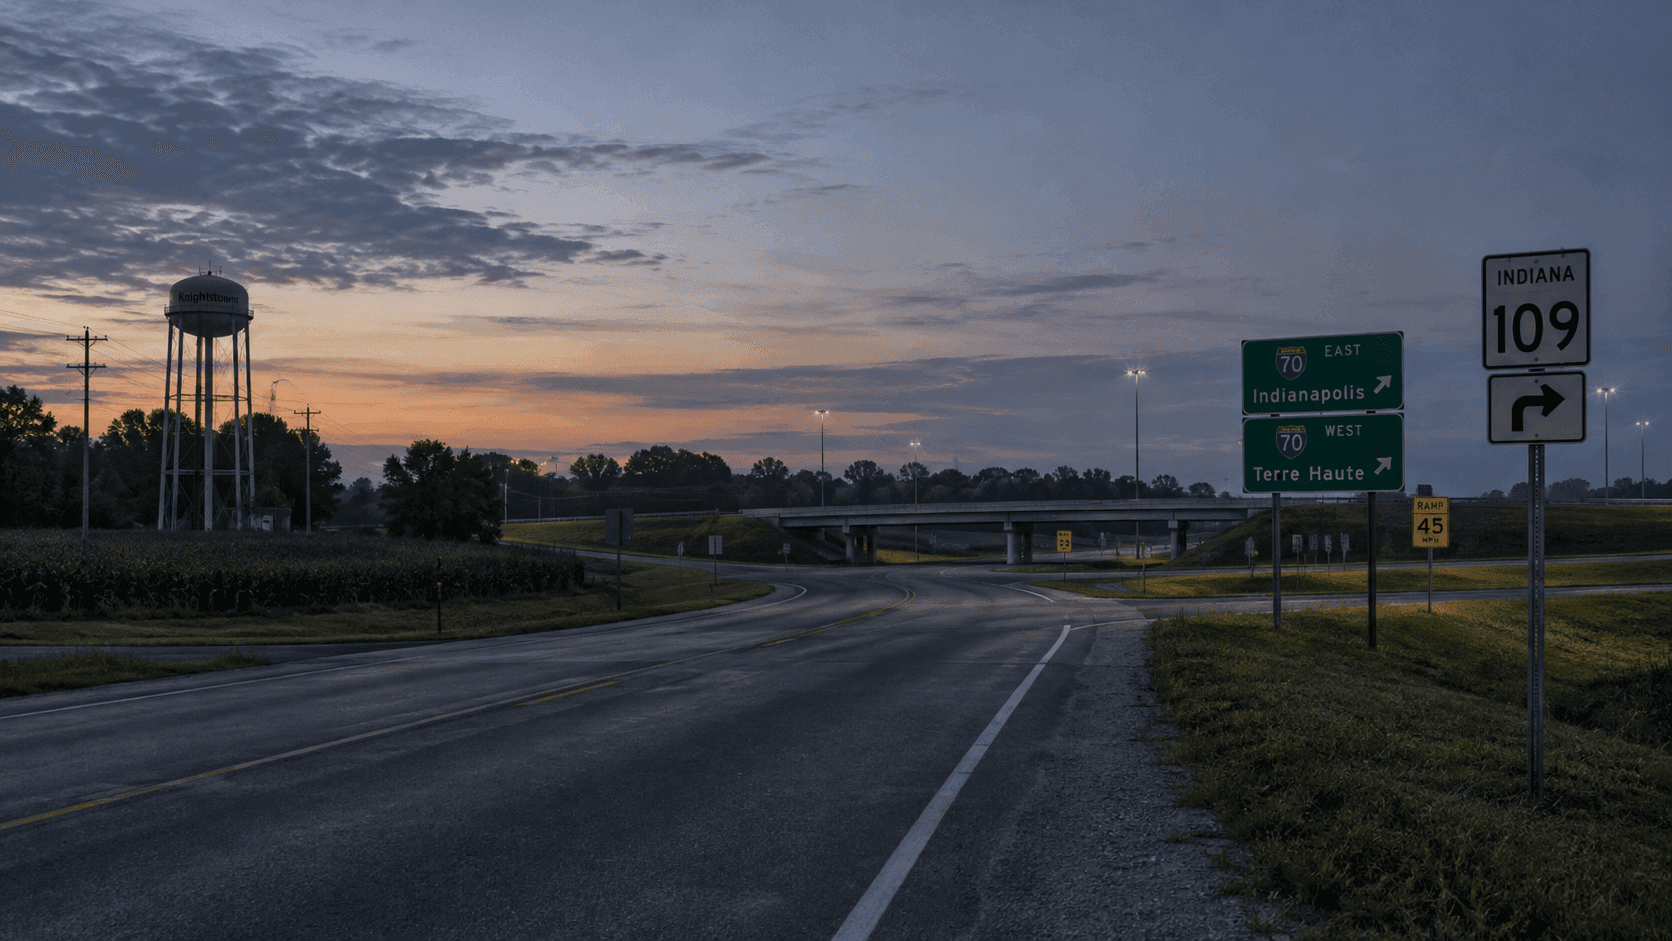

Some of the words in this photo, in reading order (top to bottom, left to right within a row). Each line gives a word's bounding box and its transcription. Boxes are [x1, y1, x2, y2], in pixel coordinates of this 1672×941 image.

[1497, 265, 1575, 286] INDIANA
[1493, 300, 1580, 354] 109
[1324, 344, 1361, 357] EAST
[1280, 355, 1303, 373] 70
[1253, 385, 1365, 405] Indianapolis
[1324, 424, 1362, 437] WEST
[1280, 434, 1303, 451] 70
[1253, 467, 1300, 482] Terre
[1309, 465, 1365, 481] Haute
[1417, 501, 1444, 511] RAMP
[1417, 517, 1444, 535] 45
